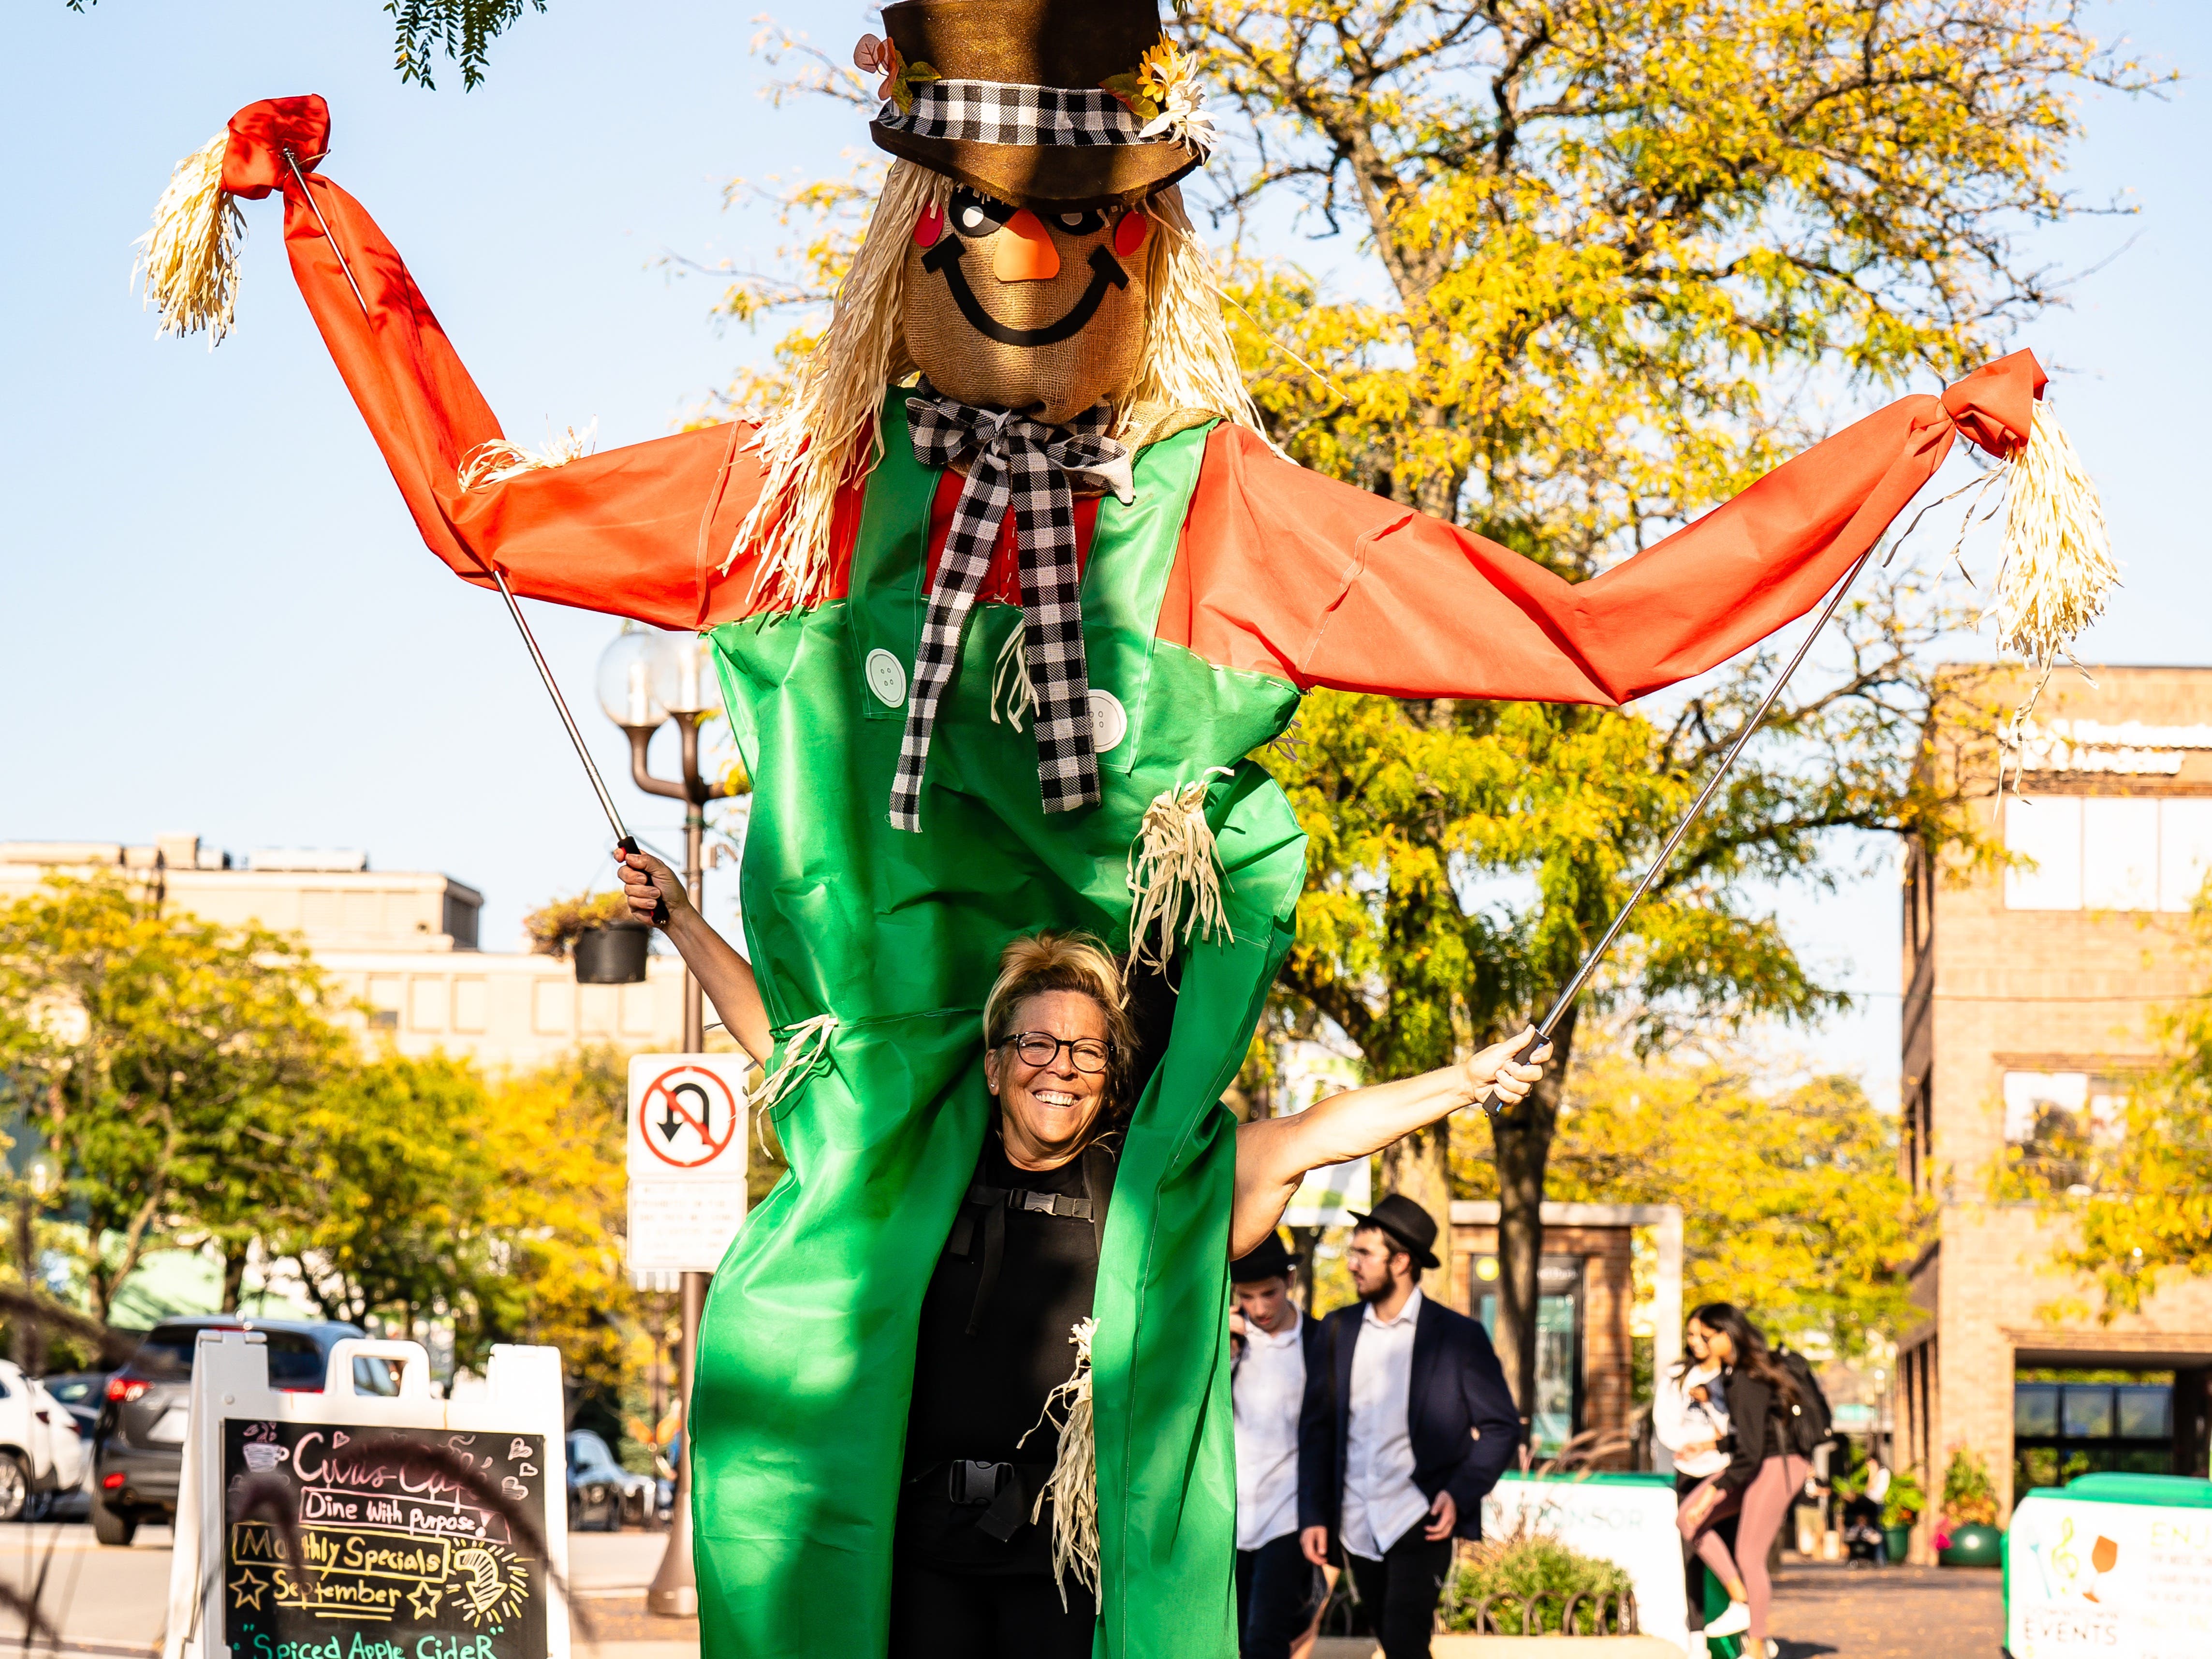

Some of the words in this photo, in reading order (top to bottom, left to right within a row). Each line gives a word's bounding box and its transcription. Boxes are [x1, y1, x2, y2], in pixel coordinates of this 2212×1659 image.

[306, 1492, 357, 1520] Dine
[366, 1500, 402, 1525] With
[242, 1528, 340, 1581] Mothly
[344, 1536, 441, 1575] Specials
[272, 1570, 402, 1611] September
[347, 1631, 407, 1659] Apple
[2024, 1617, 2118, 1645] EVENTS
